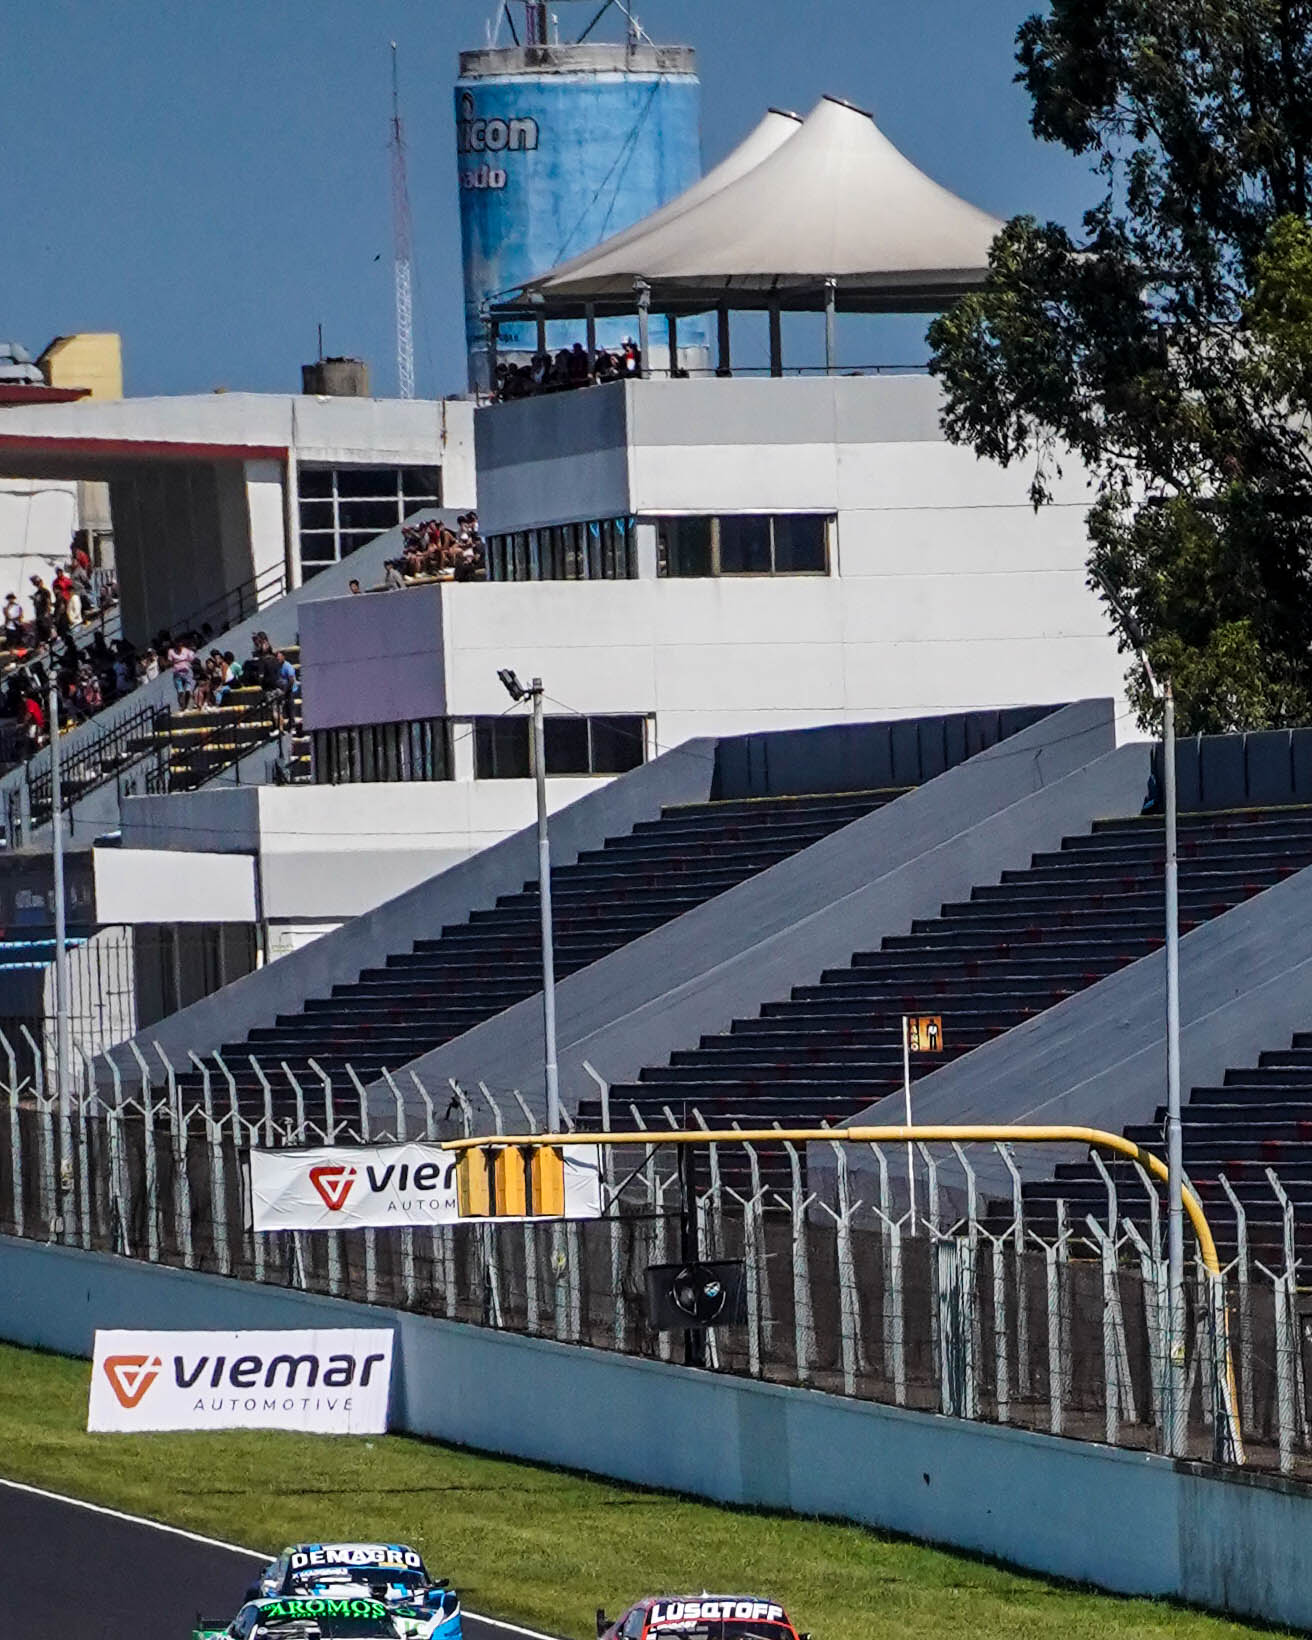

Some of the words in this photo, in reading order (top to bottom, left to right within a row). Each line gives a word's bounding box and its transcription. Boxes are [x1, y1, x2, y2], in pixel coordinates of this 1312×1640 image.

[173, 1353, 385, 1388] viemar
[192, 1397, 353, 1412] AUTOMOTIVE
[291, 1549, 420, 1569] DEMAGRO
[267, 1599, 386, 1619] AROMOS
